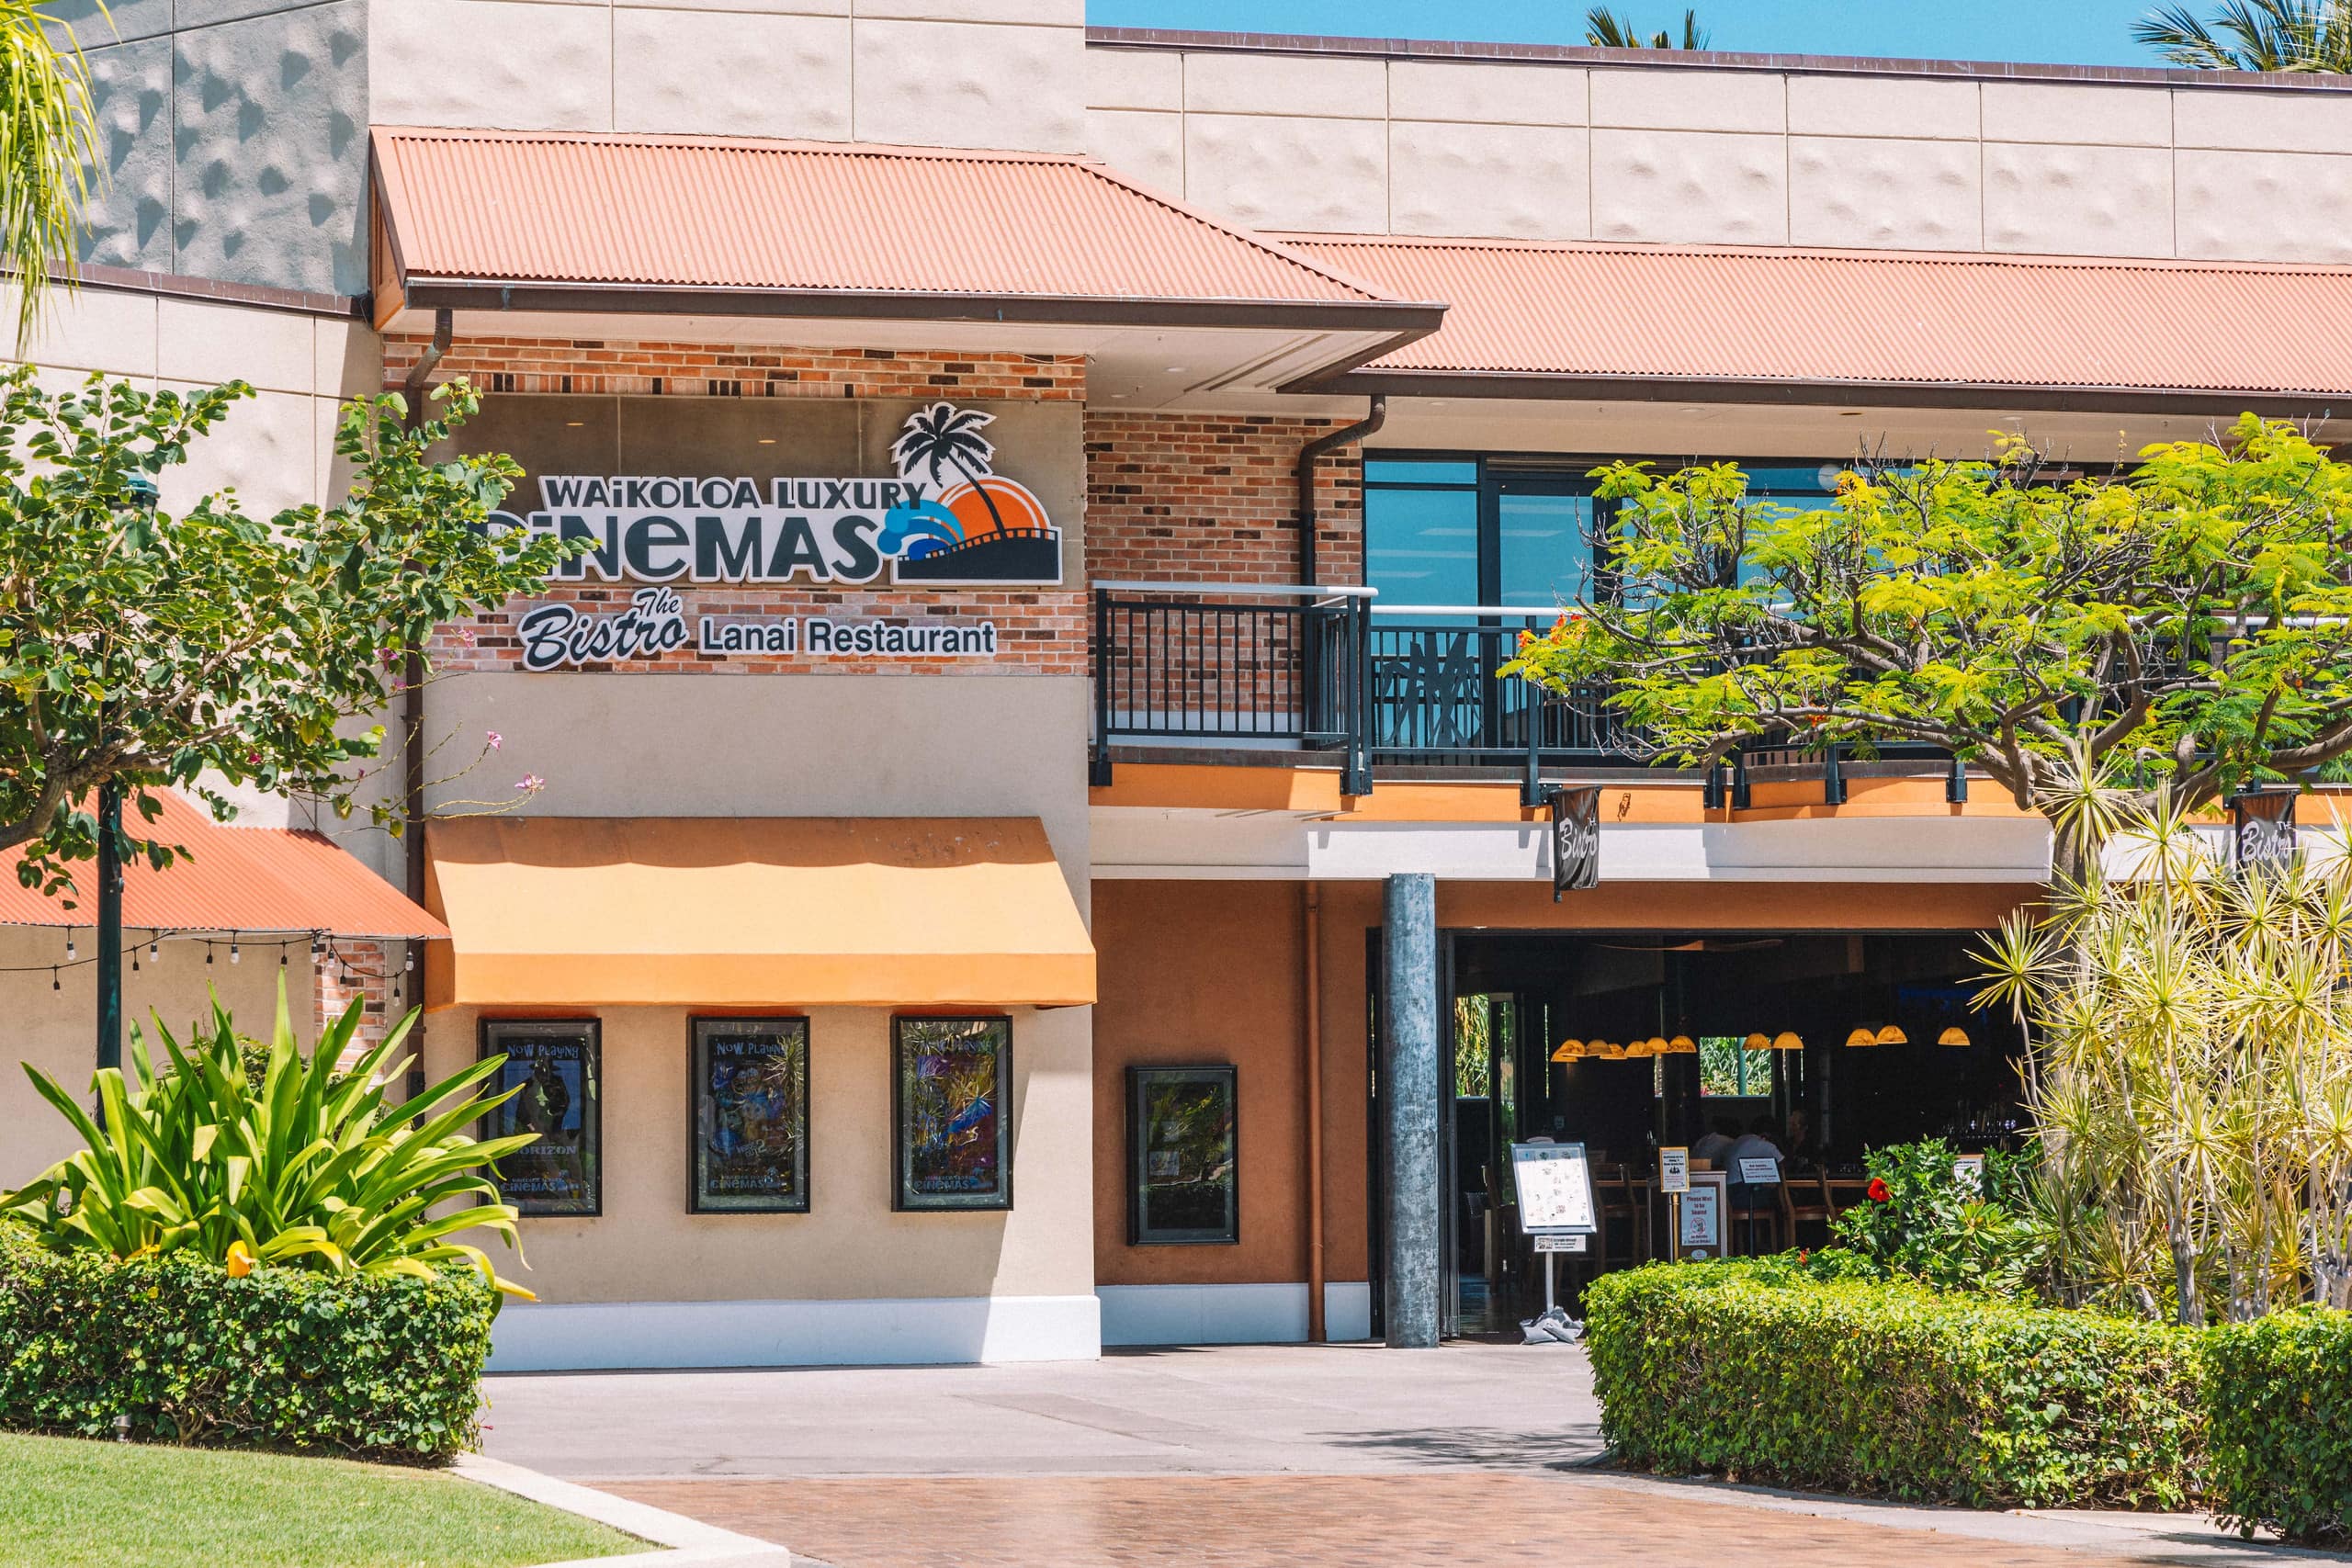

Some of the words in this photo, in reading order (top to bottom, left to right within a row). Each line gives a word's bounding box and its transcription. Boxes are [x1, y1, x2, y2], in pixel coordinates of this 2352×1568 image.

[777, 480, 927, 511] LUXURY
[636, 590, 680, 617] The
[521, 607, 687, 668] Bistro
[703, 620, 795, 652] Lanai
[808, 621, 994, 653] Restaurant
[2242, 821, 2291, 861] Bistro
[516, 1145, 577, 1155] ORIZON
